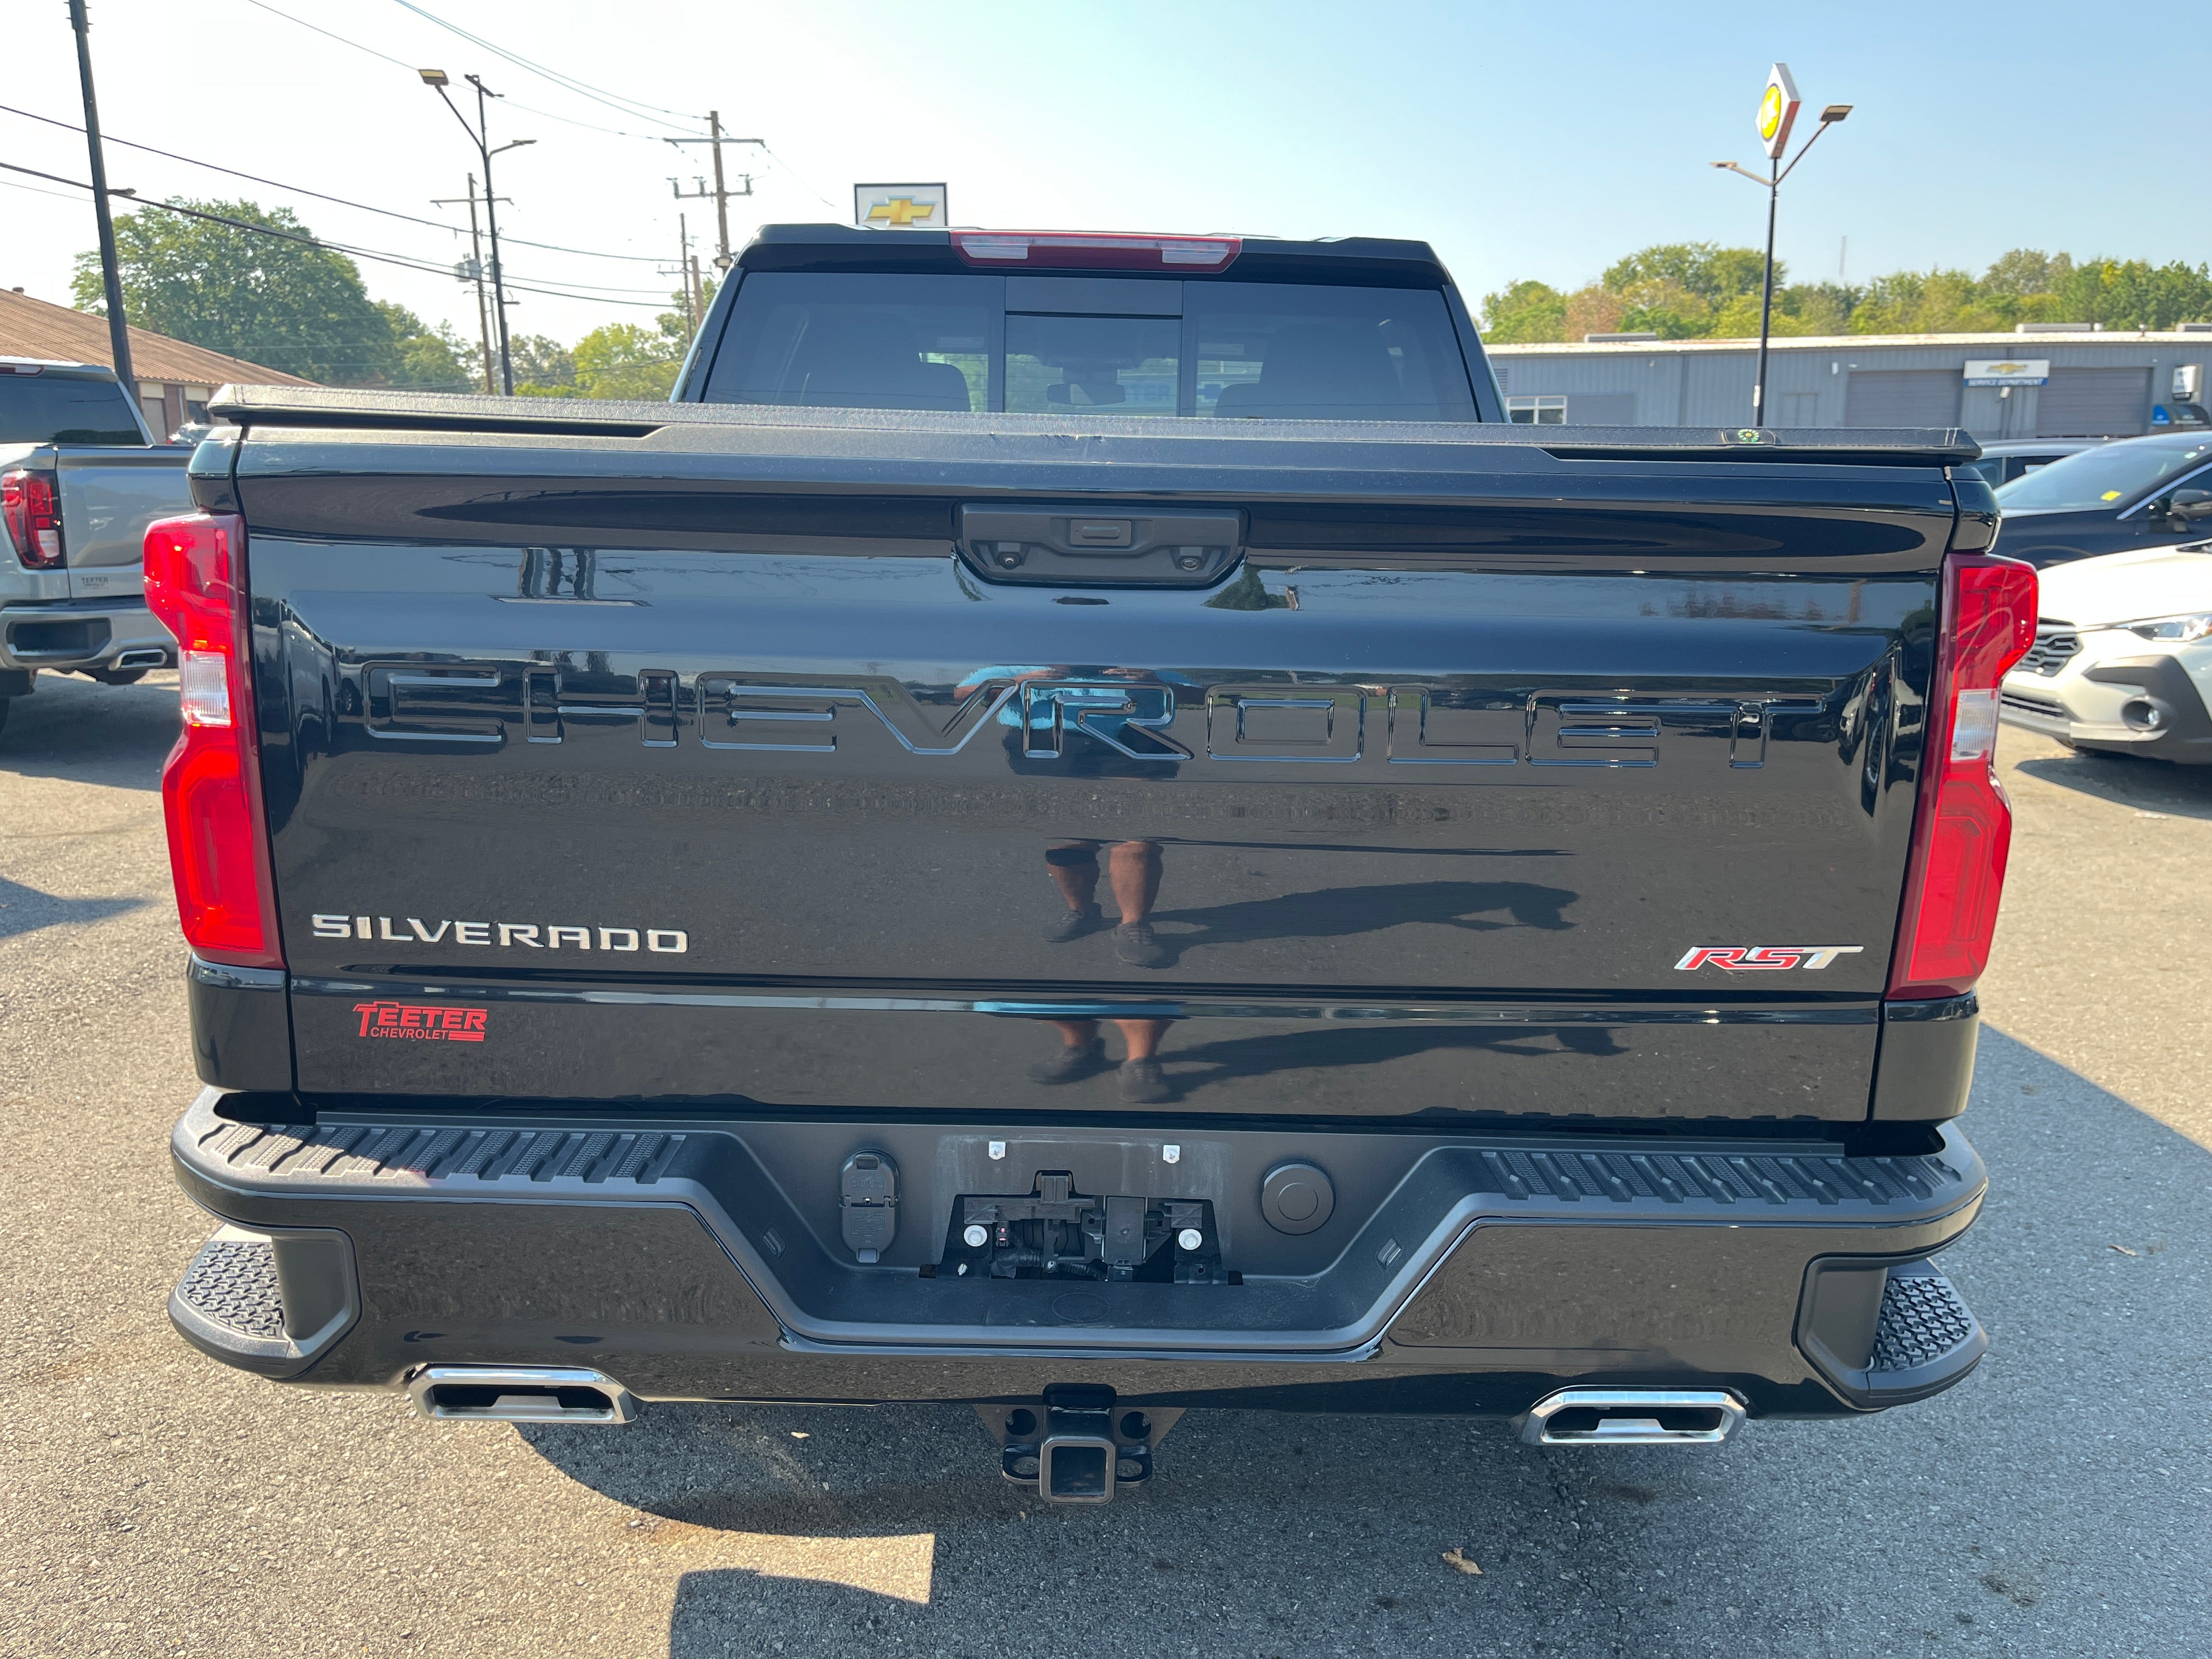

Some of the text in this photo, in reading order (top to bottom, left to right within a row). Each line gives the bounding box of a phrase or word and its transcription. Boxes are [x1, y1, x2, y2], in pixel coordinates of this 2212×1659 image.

[360, 660, 1826, 769] CHEVROLET
[312, 913, 690, 953] SILVERADO
[1674, 946, 1864, 970] RST
[353, 1001, 488, 1037] TEETER
[370, 1027, 448, 1041] CHEVROLET
